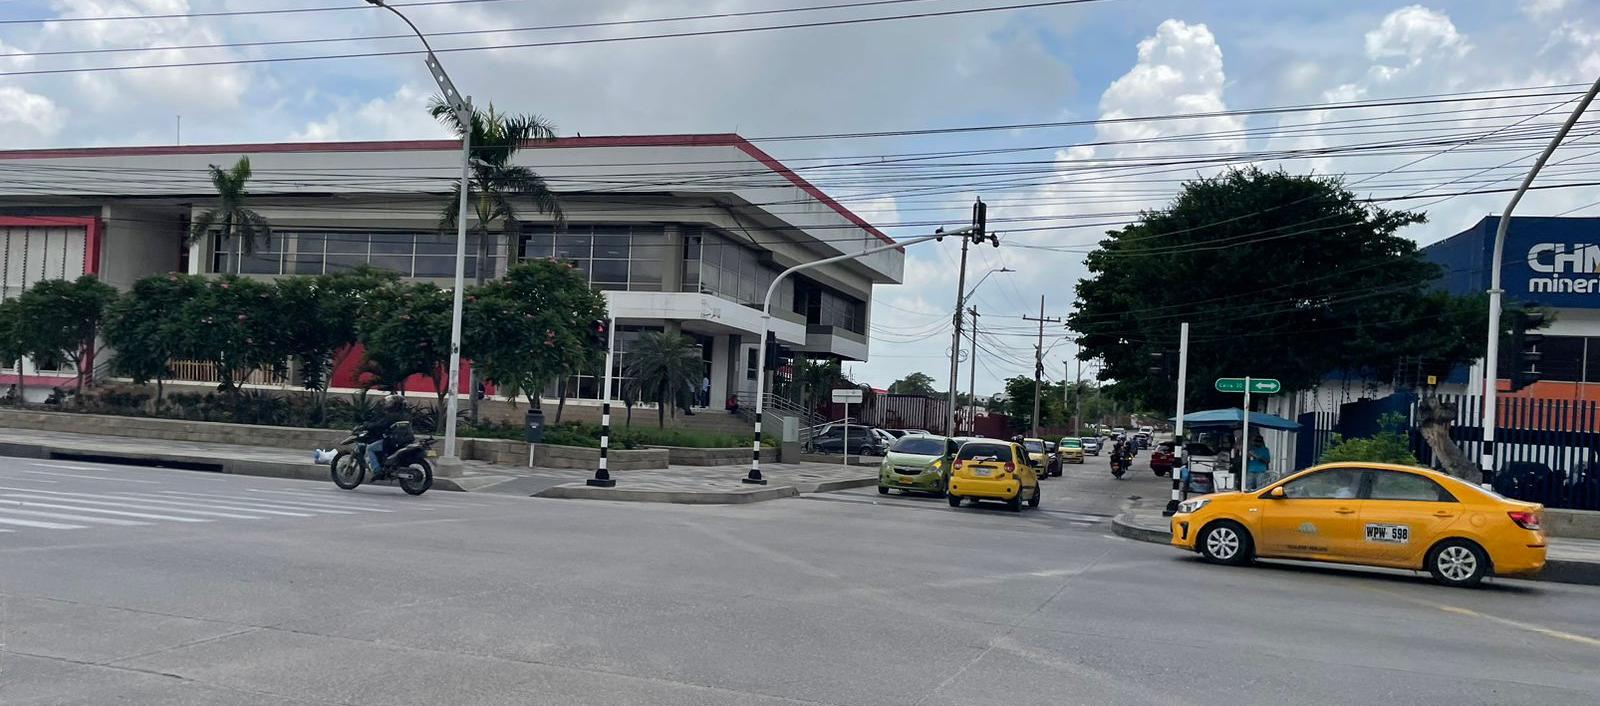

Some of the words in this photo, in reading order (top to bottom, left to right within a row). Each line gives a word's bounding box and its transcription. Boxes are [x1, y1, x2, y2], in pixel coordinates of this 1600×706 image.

[1529, 273, 1600, 293] miner
[1366, 526, 1386, 538] WPW
[1392, 528, 1408, 539] 598
